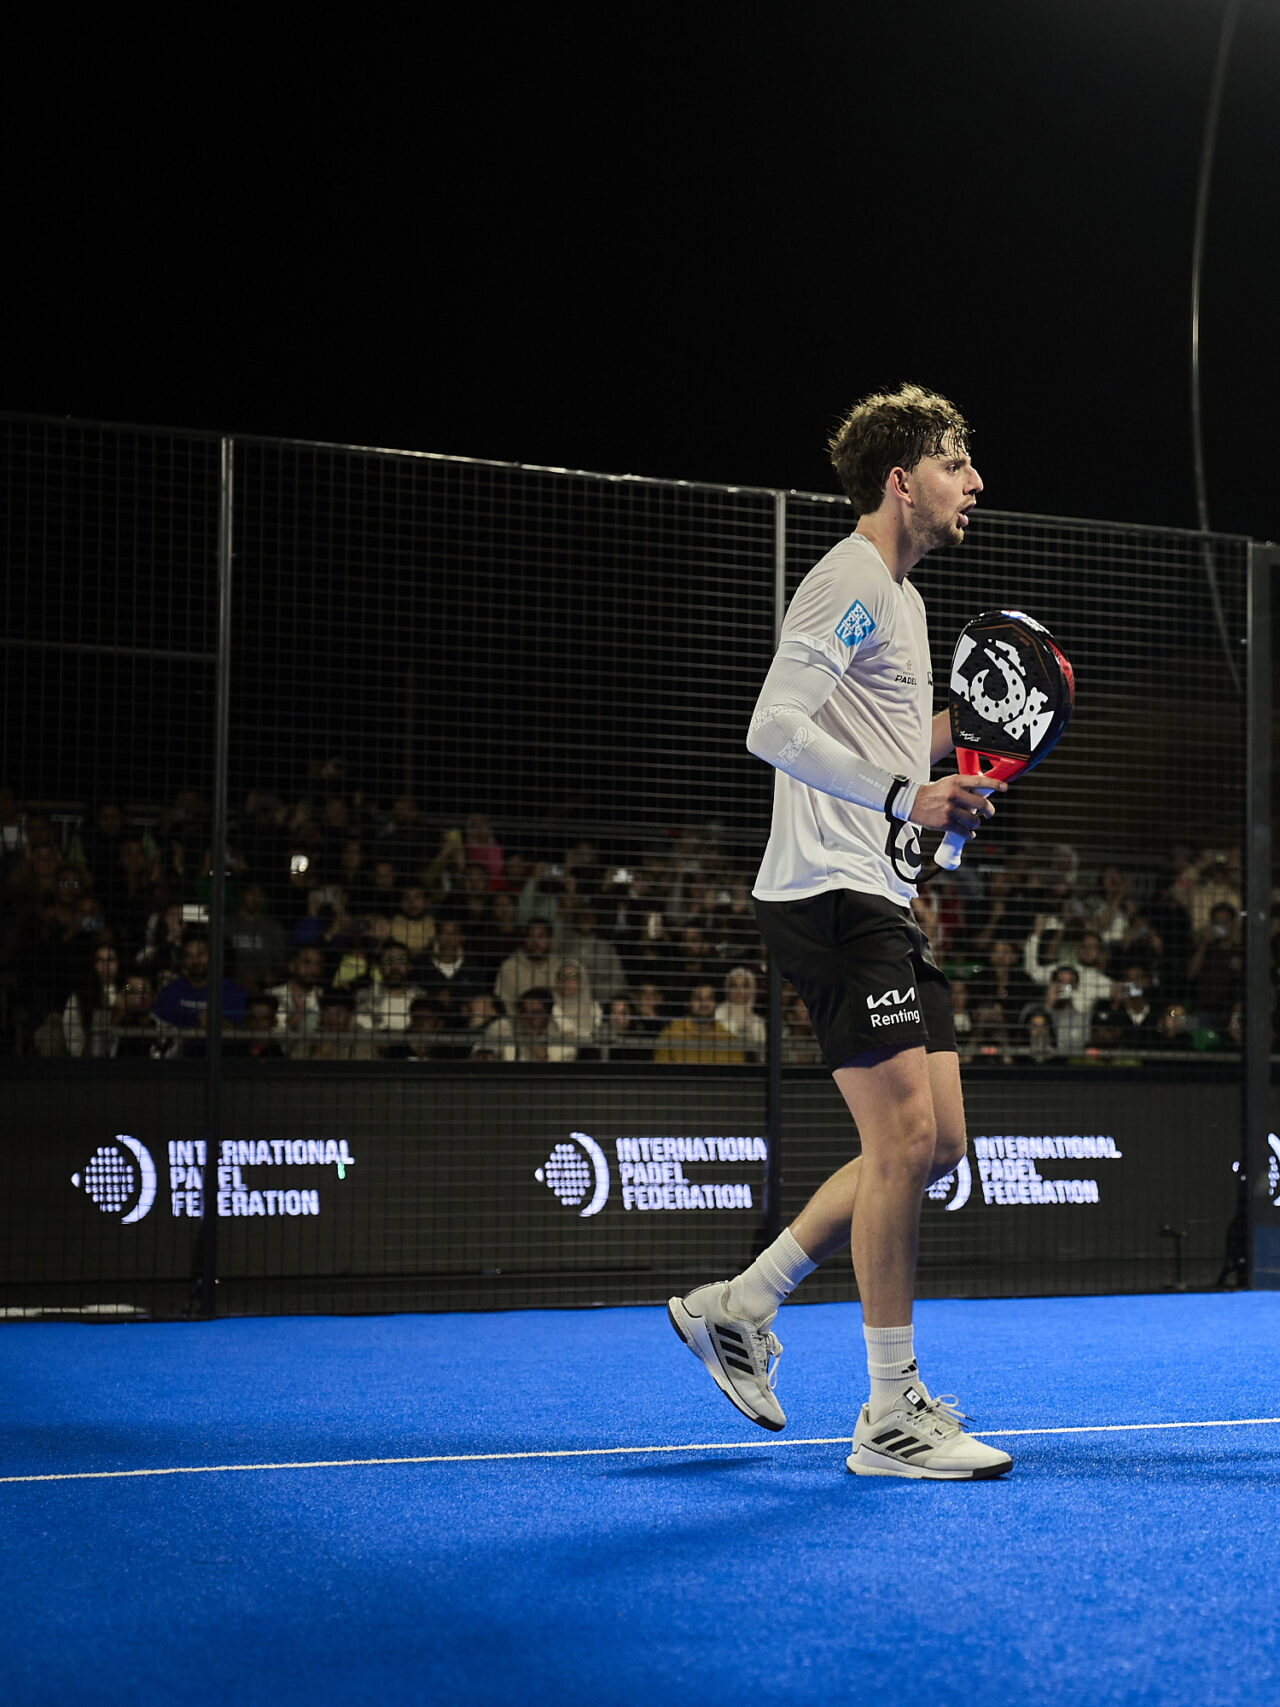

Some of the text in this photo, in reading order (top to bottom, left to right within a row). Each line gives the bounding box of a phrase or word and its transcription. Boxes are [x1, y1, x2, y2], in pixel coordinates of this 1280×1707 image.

[870, 1008, 920, 1028] Renting
[168, 1140, 355, 1165] INTRNATIONAL
[616, 1136, 767, 1161] INTERNATIONA
[973, 1135, 1122, 1159] INTERNATIONAL
[170, 1165, 248, 1191] PAEL
[619, 1161, 690, 1186] PADEL
[977, 1158, 1042, 1182] PADEL
[172, 1190, 320, 1217] FEERATION
[621, 1184, 752, 1211] FEDERATION
[982, 1180, 1100, 1205] FEDERATION
